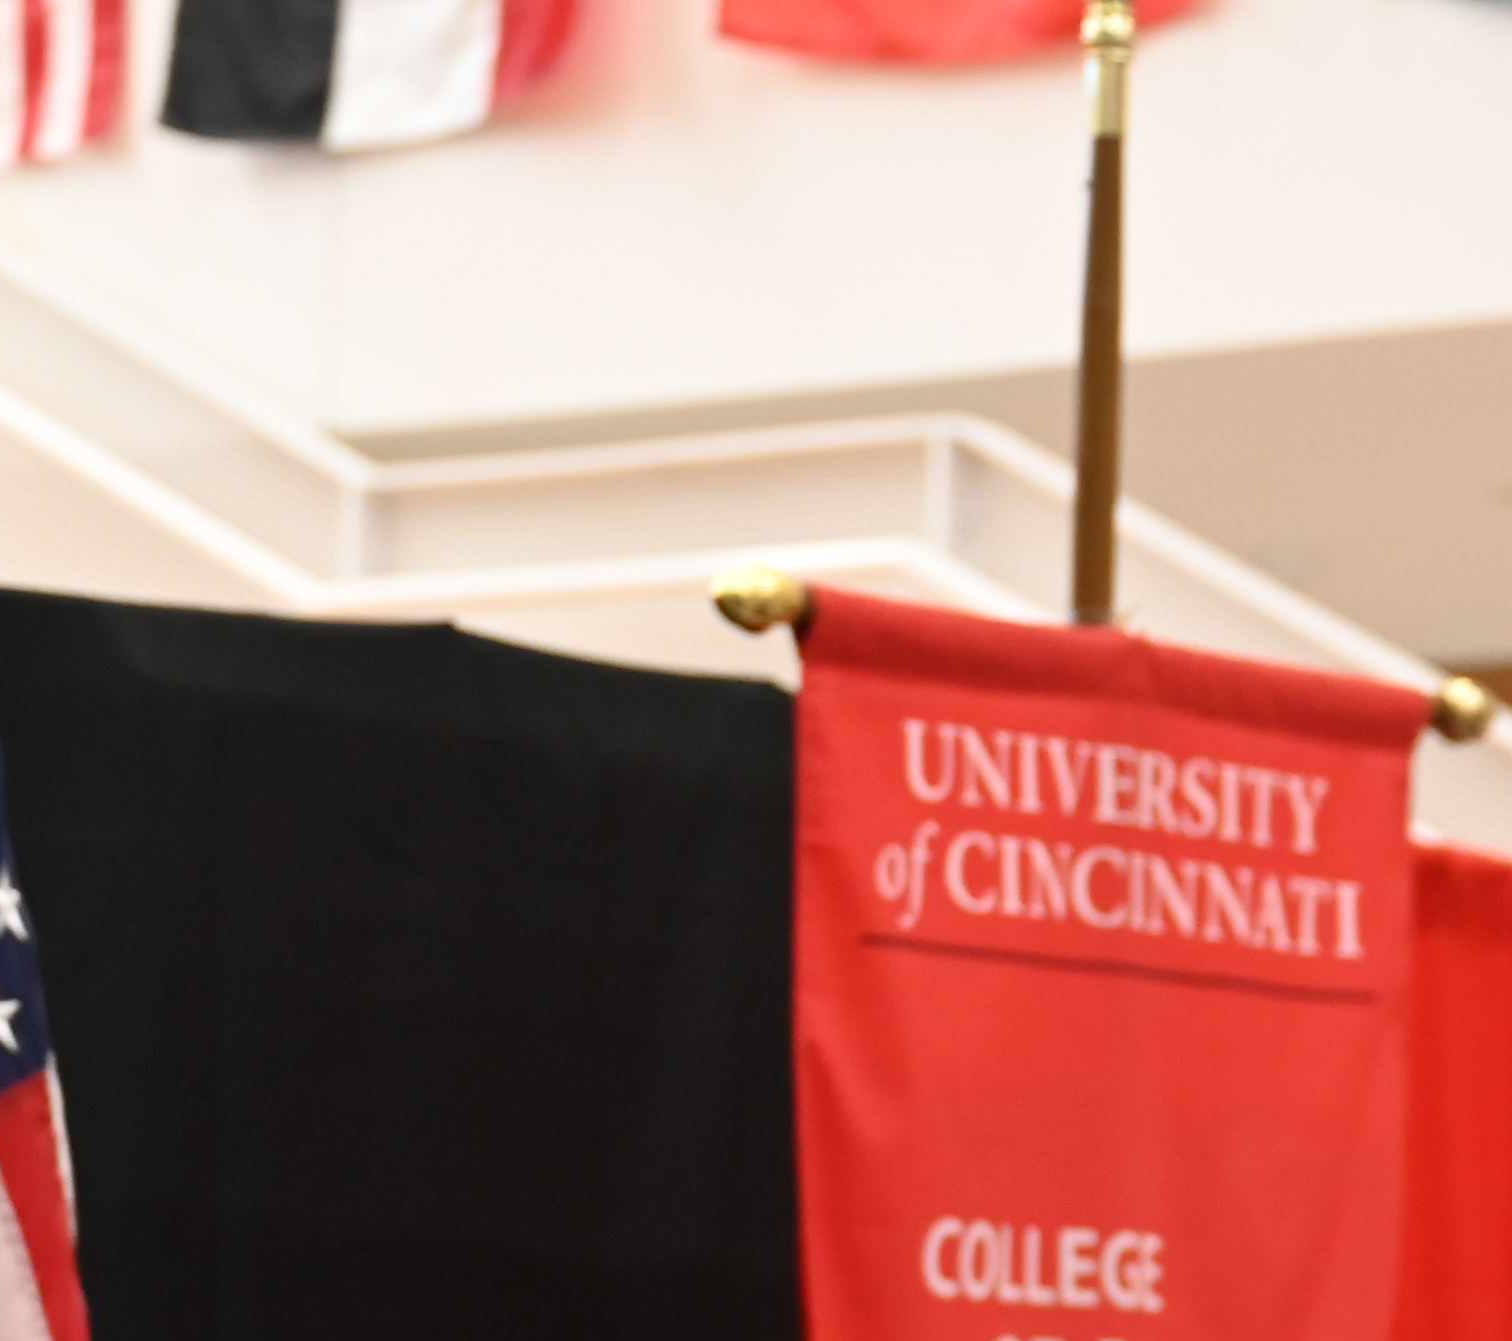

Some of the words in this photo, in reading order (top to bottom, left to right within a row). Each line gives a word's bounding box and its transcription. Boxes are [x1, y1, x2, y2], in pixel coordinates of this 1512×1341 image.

[902, 718, 1330, 853] UNIVERSITY
[873, 821, 939, 930] of
[945, 831, 1364, 960] CINCINNATI
[922, 1216, 1166, 1313] COLLEGE
